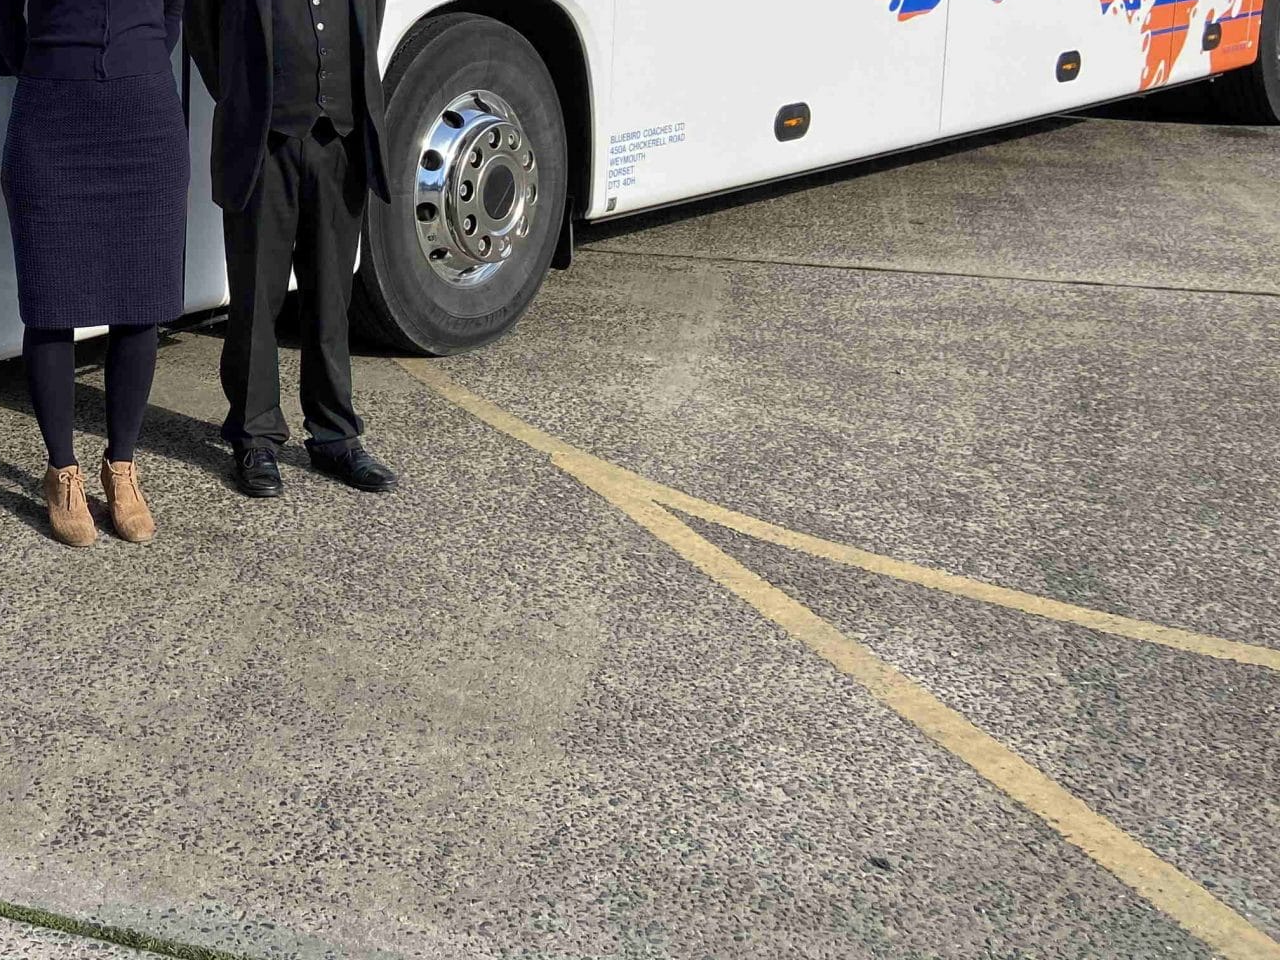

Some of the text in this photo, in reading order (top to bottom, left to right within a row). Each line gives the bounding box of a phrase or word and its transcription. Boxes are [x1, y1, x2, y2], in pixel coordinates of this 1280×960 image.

[610, 122, 686, 144] BLUEBIRD COACHES LTD
[628, 137, 666, 152] CHICKERELL
[668, 133, 686, 143] ROAD
[610, 153, 645, 166] WEYMOUTH
[609, 166, 635, 178] DORSET
[608, 180, 620, 190] DT3
